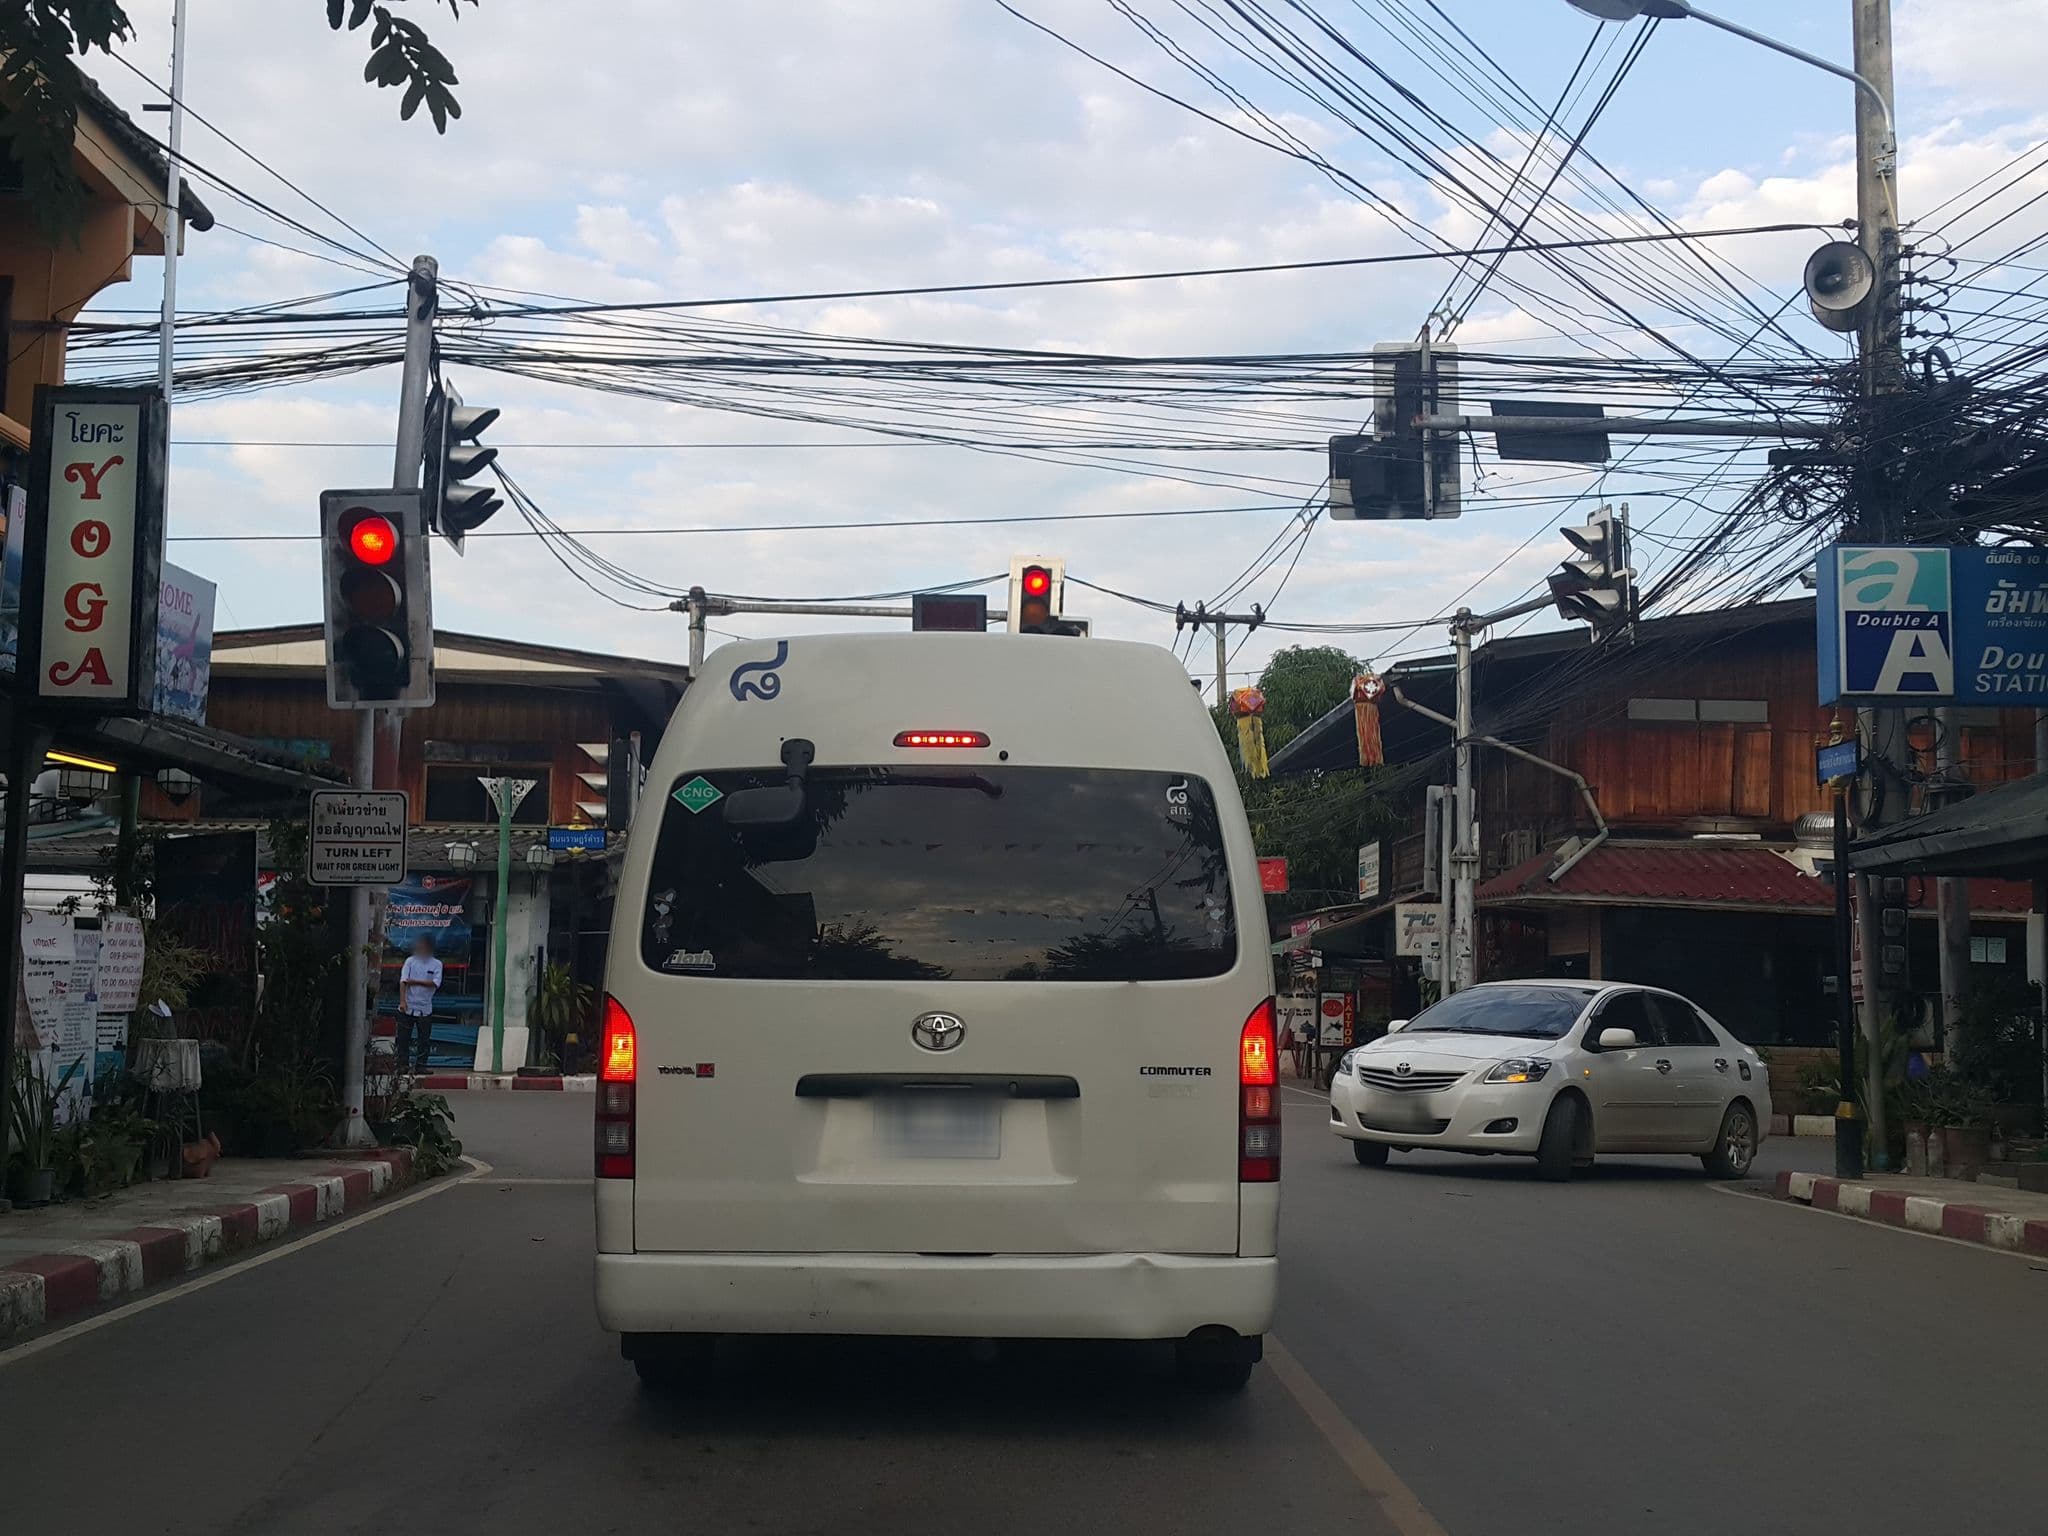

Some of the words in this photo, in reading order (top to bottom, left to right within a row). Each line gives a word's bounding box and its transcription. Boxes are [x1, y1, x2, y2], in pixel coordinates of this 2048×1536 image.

[65, 412, 124, 443] โยคะ
[49, 455, 125, 686] YOGA
[1857, 614, 1920, 627] Double
[1926, 614, 1940, 627] A
[1979, 646, 2046, 670] Dou
[1975, 673, 2048, 692] STATI
[681, 786, 714, 799] CNG
[325, 848, 358, 858] TURN
[362, 848, 392, 858] LEFT
[316, 862, 334, 871] WAIT
[336, 862, 351, 871] FOR
[352, 863, 377, 871] GREEN
[378, 863, 400, 872] LIGHT
[1344, 995, 1353, 1044] TATTOO
[1140, 1066, 1211, 1076] COMMUTER
